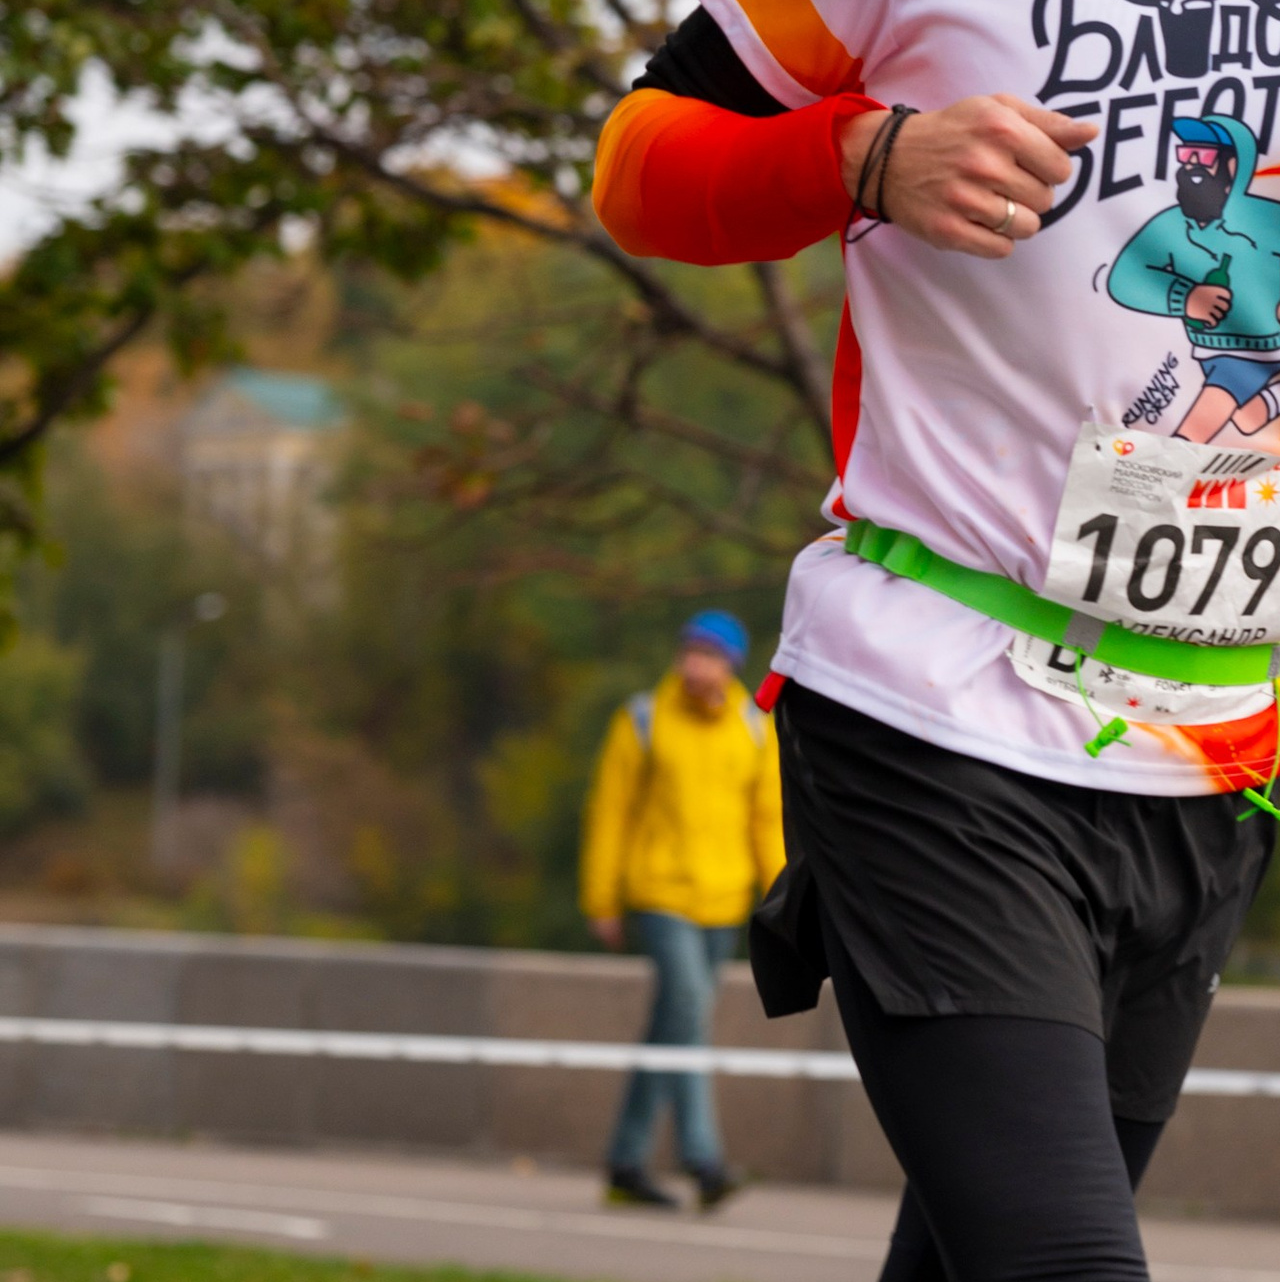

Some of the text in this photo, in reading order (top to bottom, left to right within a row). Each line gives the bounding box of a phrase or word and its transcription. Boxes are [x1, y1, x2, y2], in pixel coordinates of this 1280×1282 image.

[1121, 351, 1179, 429] RUNNING
[1145, 372, 1180, 425] CREW
[1113, 619, 1267, 645] ЛЕКСАНДР
